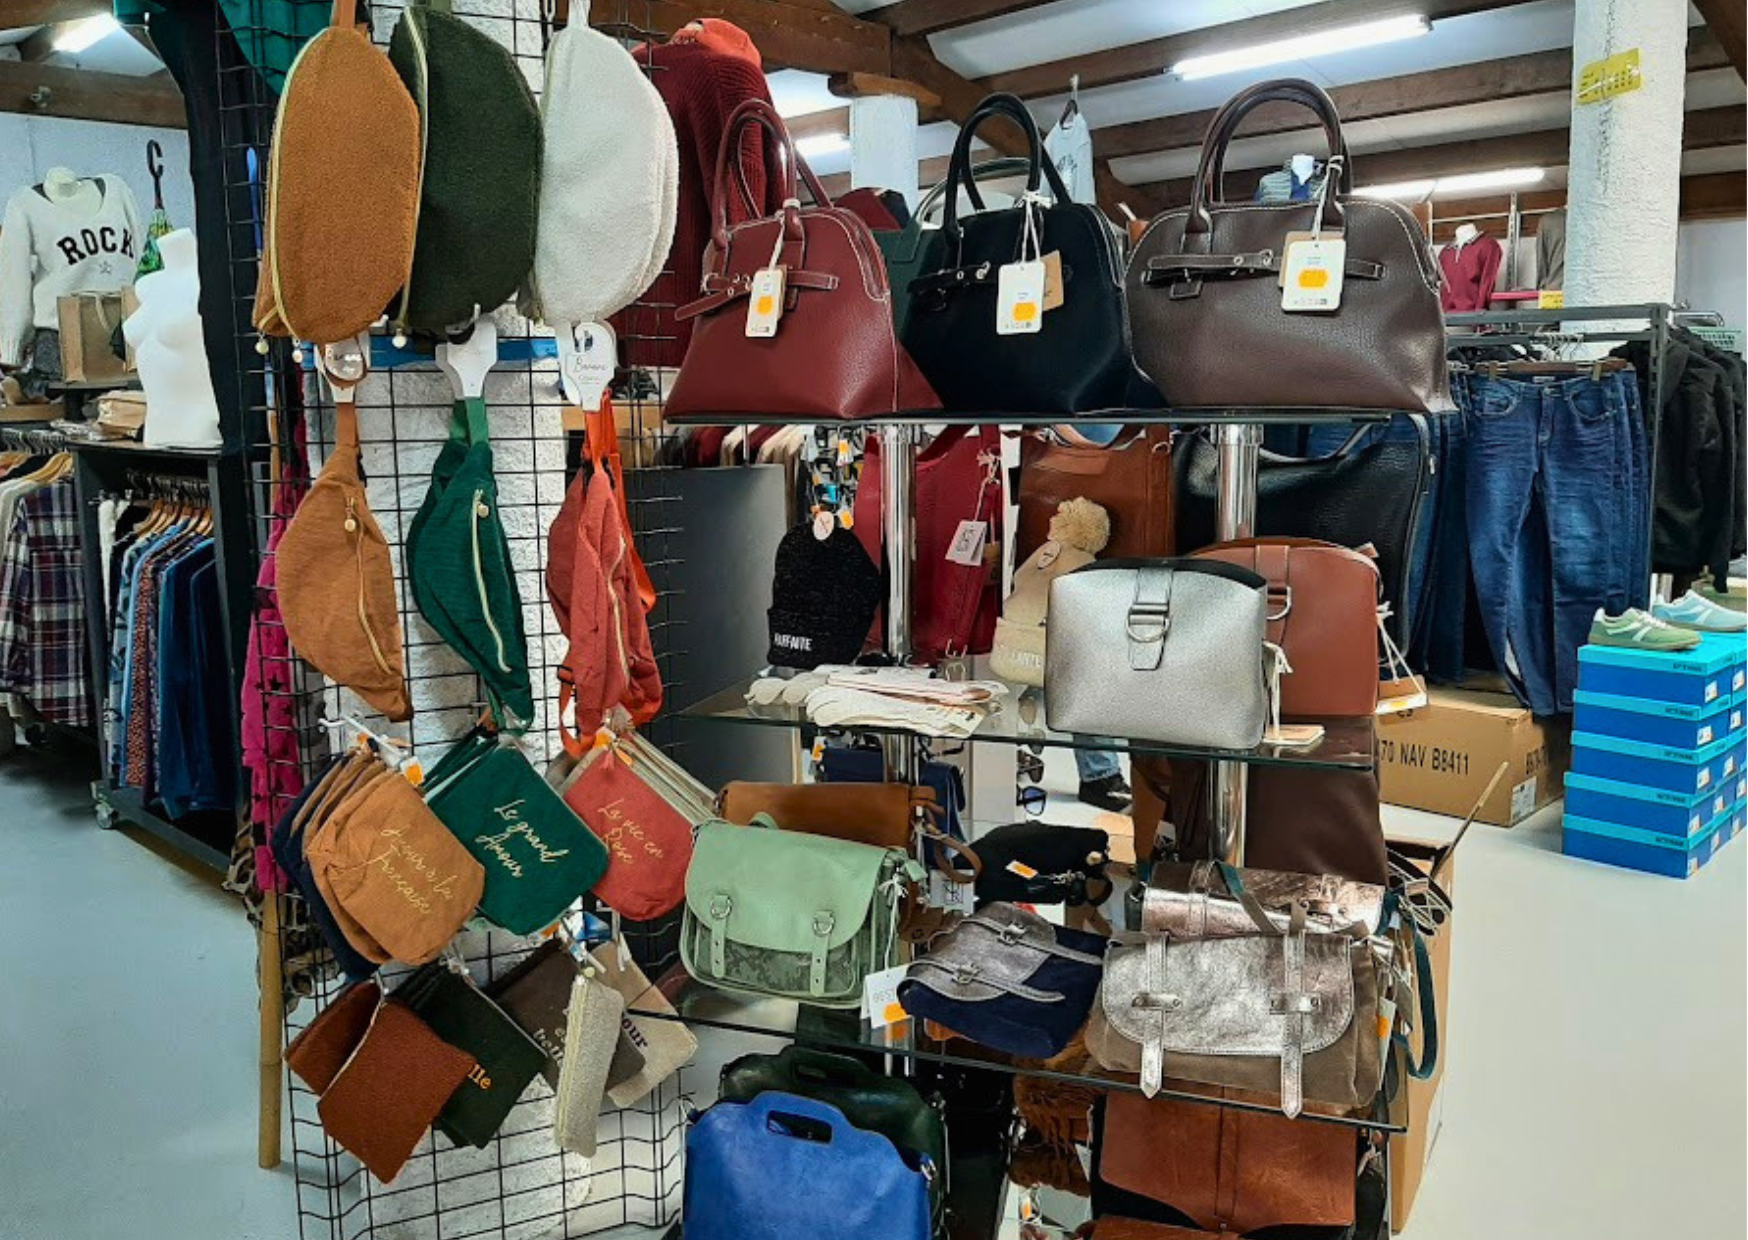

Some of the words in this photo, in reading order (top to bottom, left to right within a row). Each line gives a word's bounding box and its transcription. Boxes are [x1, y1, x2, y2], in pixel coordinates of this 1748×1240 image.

[57, 226, 134, 266] ROCK
[1400, 742, 1427, 768] NAV
[493, 799, 527, 821] Le
[474, 833, 524, 878] Amour
[505, 821, 570, 863] grand
